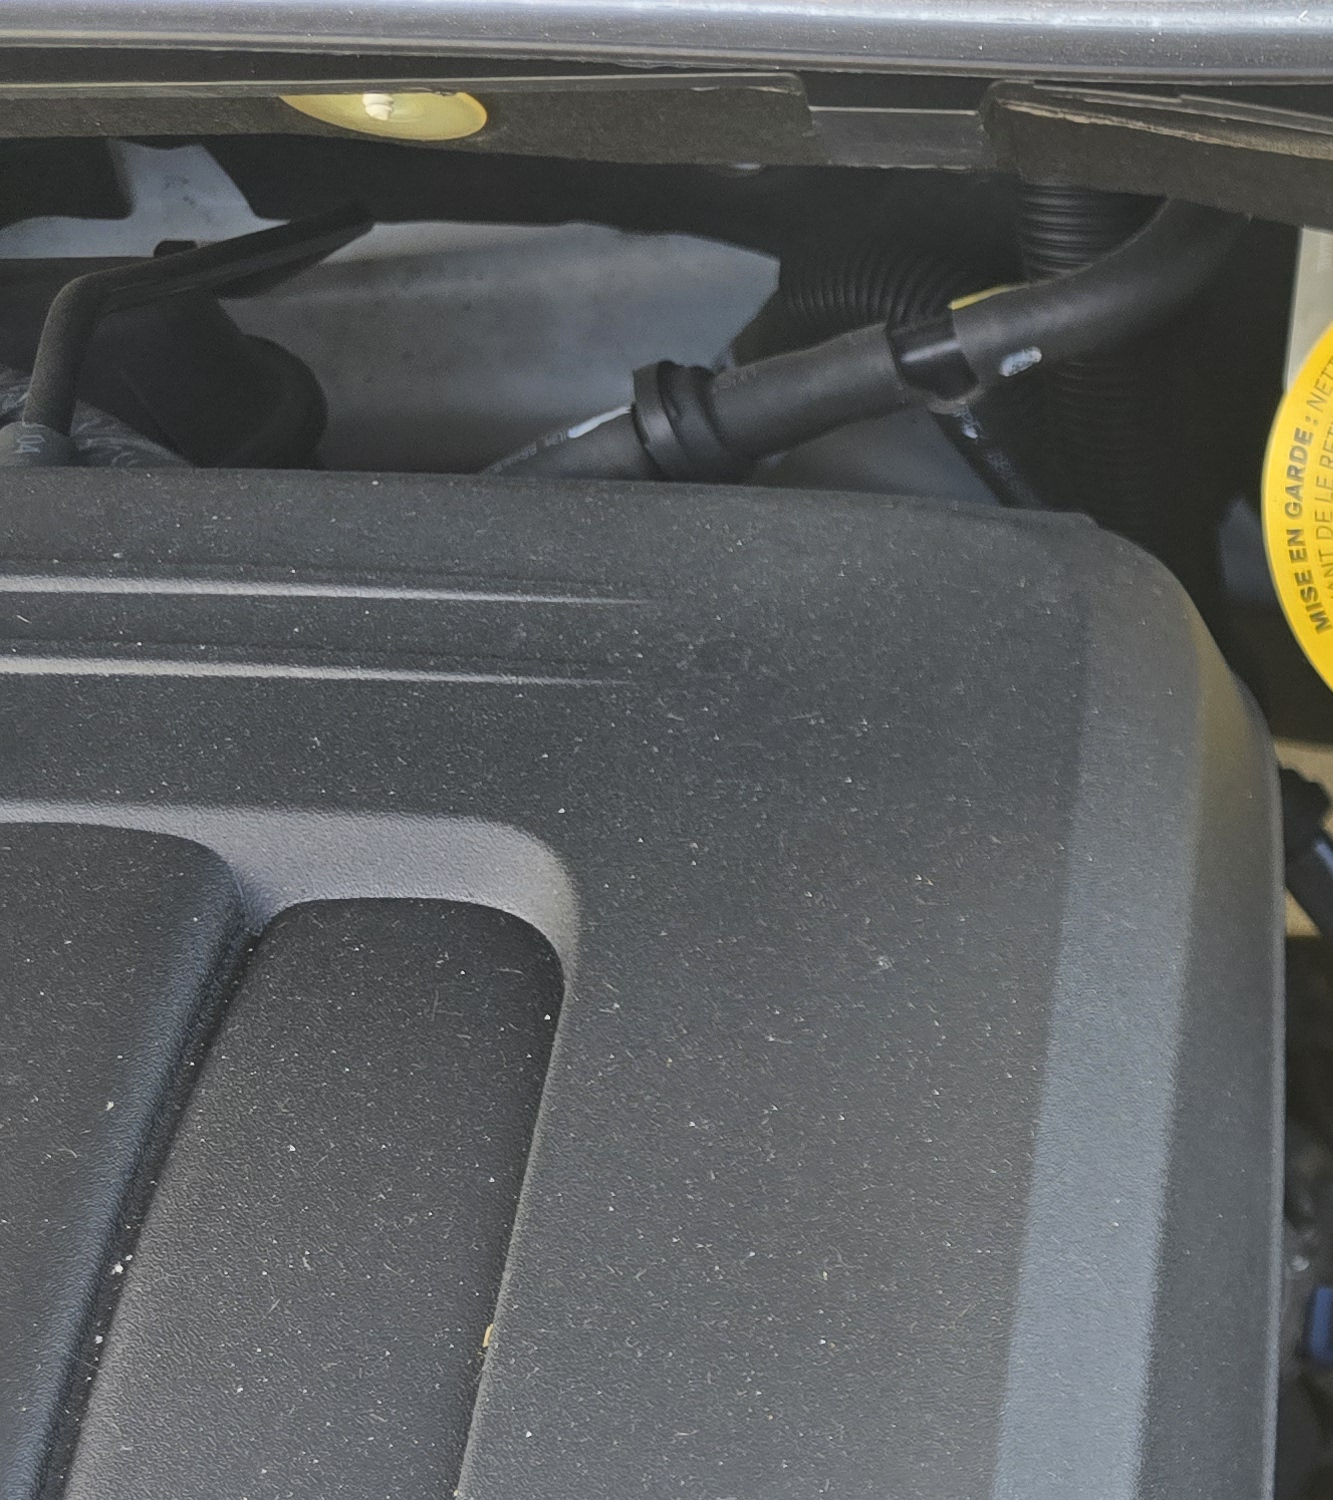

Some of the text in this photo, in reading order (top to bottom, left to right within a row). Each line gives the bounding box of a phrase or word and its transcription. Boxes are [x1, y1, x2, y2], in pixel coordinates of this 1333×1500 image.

[1284, 427, 1314, 519] GARDE
[1285, 528, 1307, 564] EN
[1293, 569, 1333, 634] MISE
